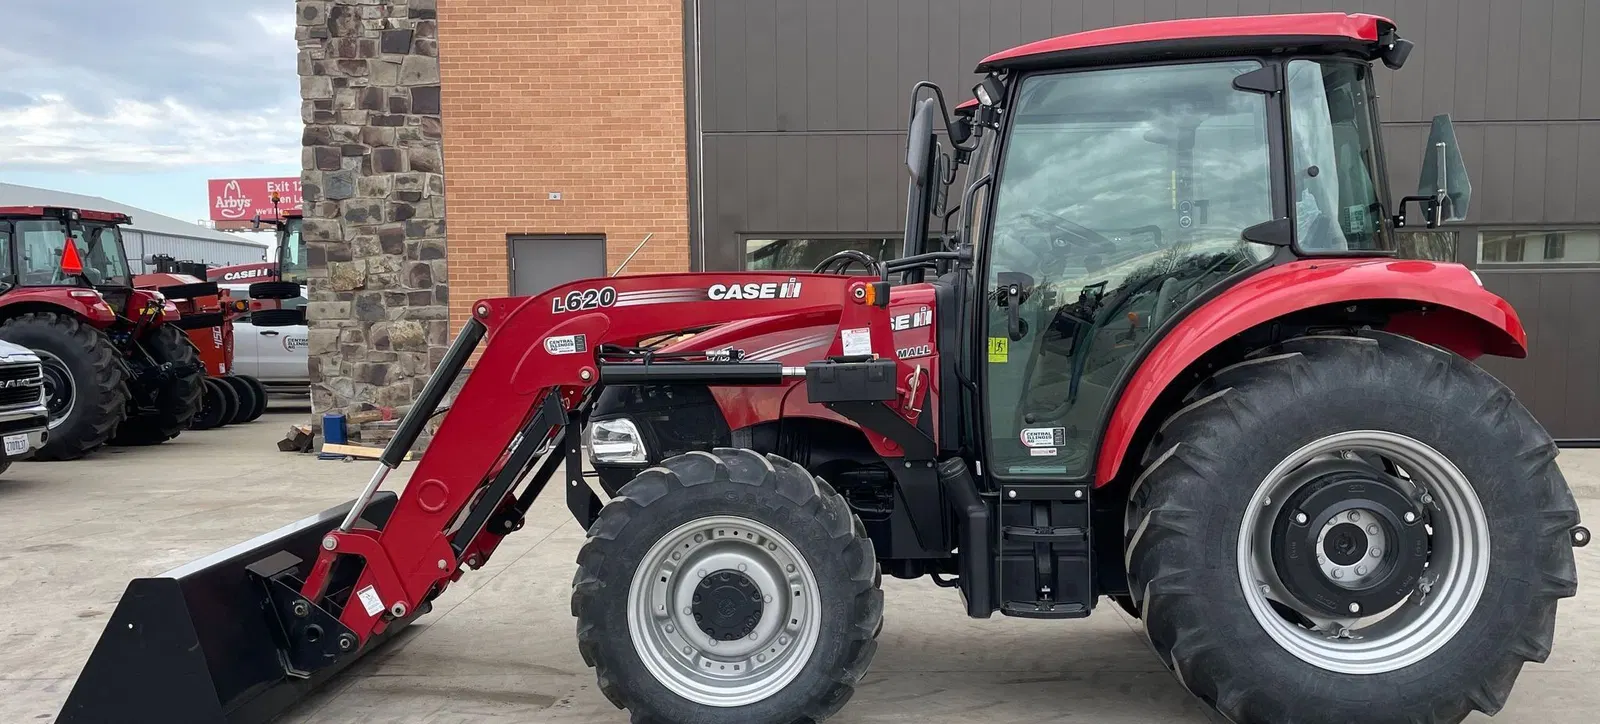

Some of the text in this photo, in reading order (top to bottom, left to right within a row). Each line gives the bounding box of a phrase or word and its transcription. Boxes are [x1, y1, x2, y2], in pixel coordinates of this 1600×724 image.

[267, 181, 290, 192] Exit
[215, 194, 251, 211] Arby's
[268, 195, 291, 203] Ten
[224, 269, 257, 281] CASE
[707, 282, 777, 300] CASE
[551, 286, 616, 314] L620
[897, 345, 931, 359] MALL
